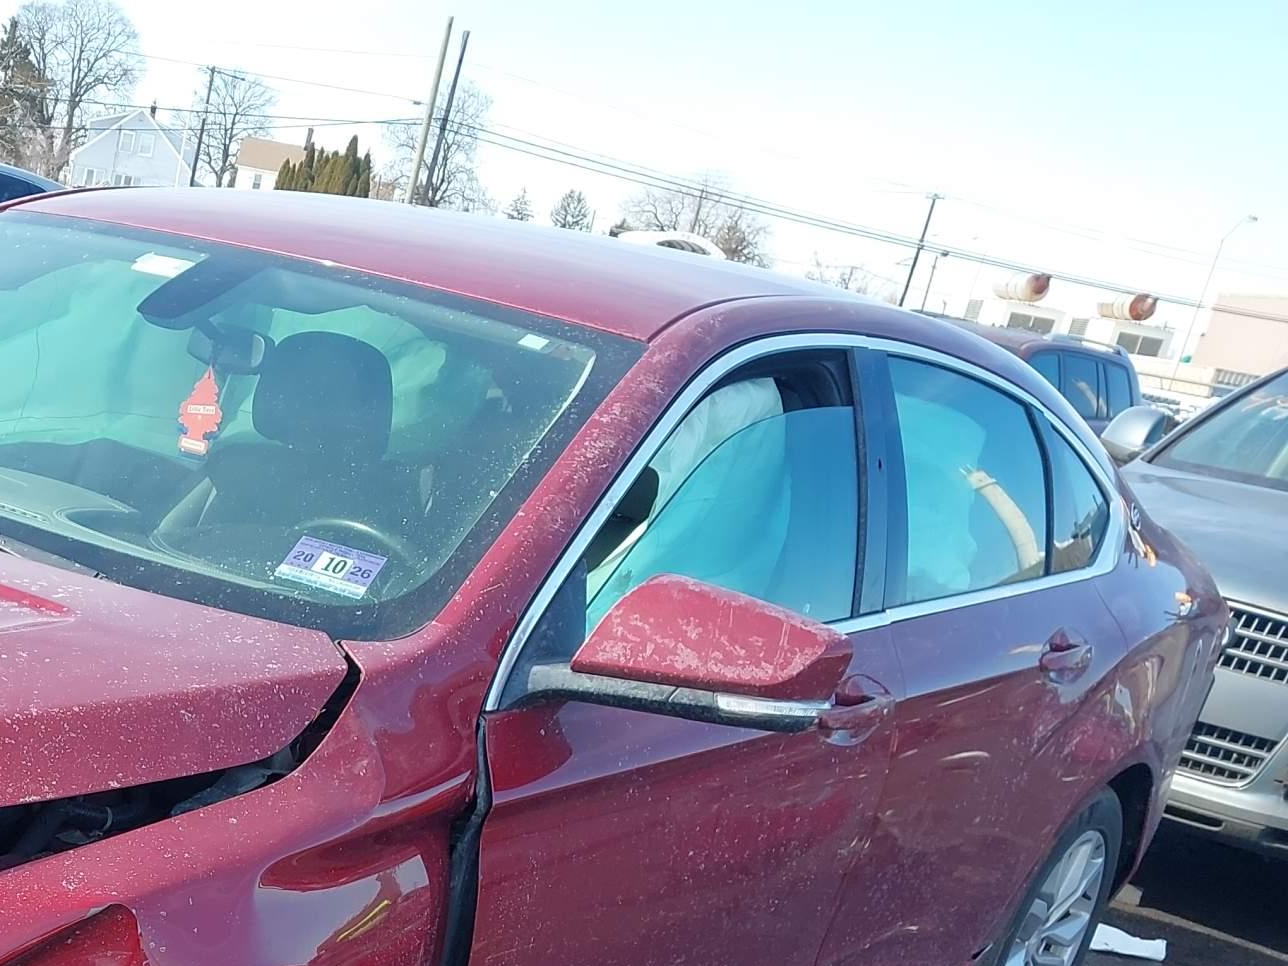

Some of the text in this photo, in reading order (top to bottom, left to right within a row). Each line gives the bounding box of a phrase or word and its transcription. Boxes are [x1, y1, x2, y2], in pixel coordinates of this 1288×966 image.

[292, 550, 315, 563] 20
[320, 556, 348, 575] 10
[349, 565, 373, 580] 26
